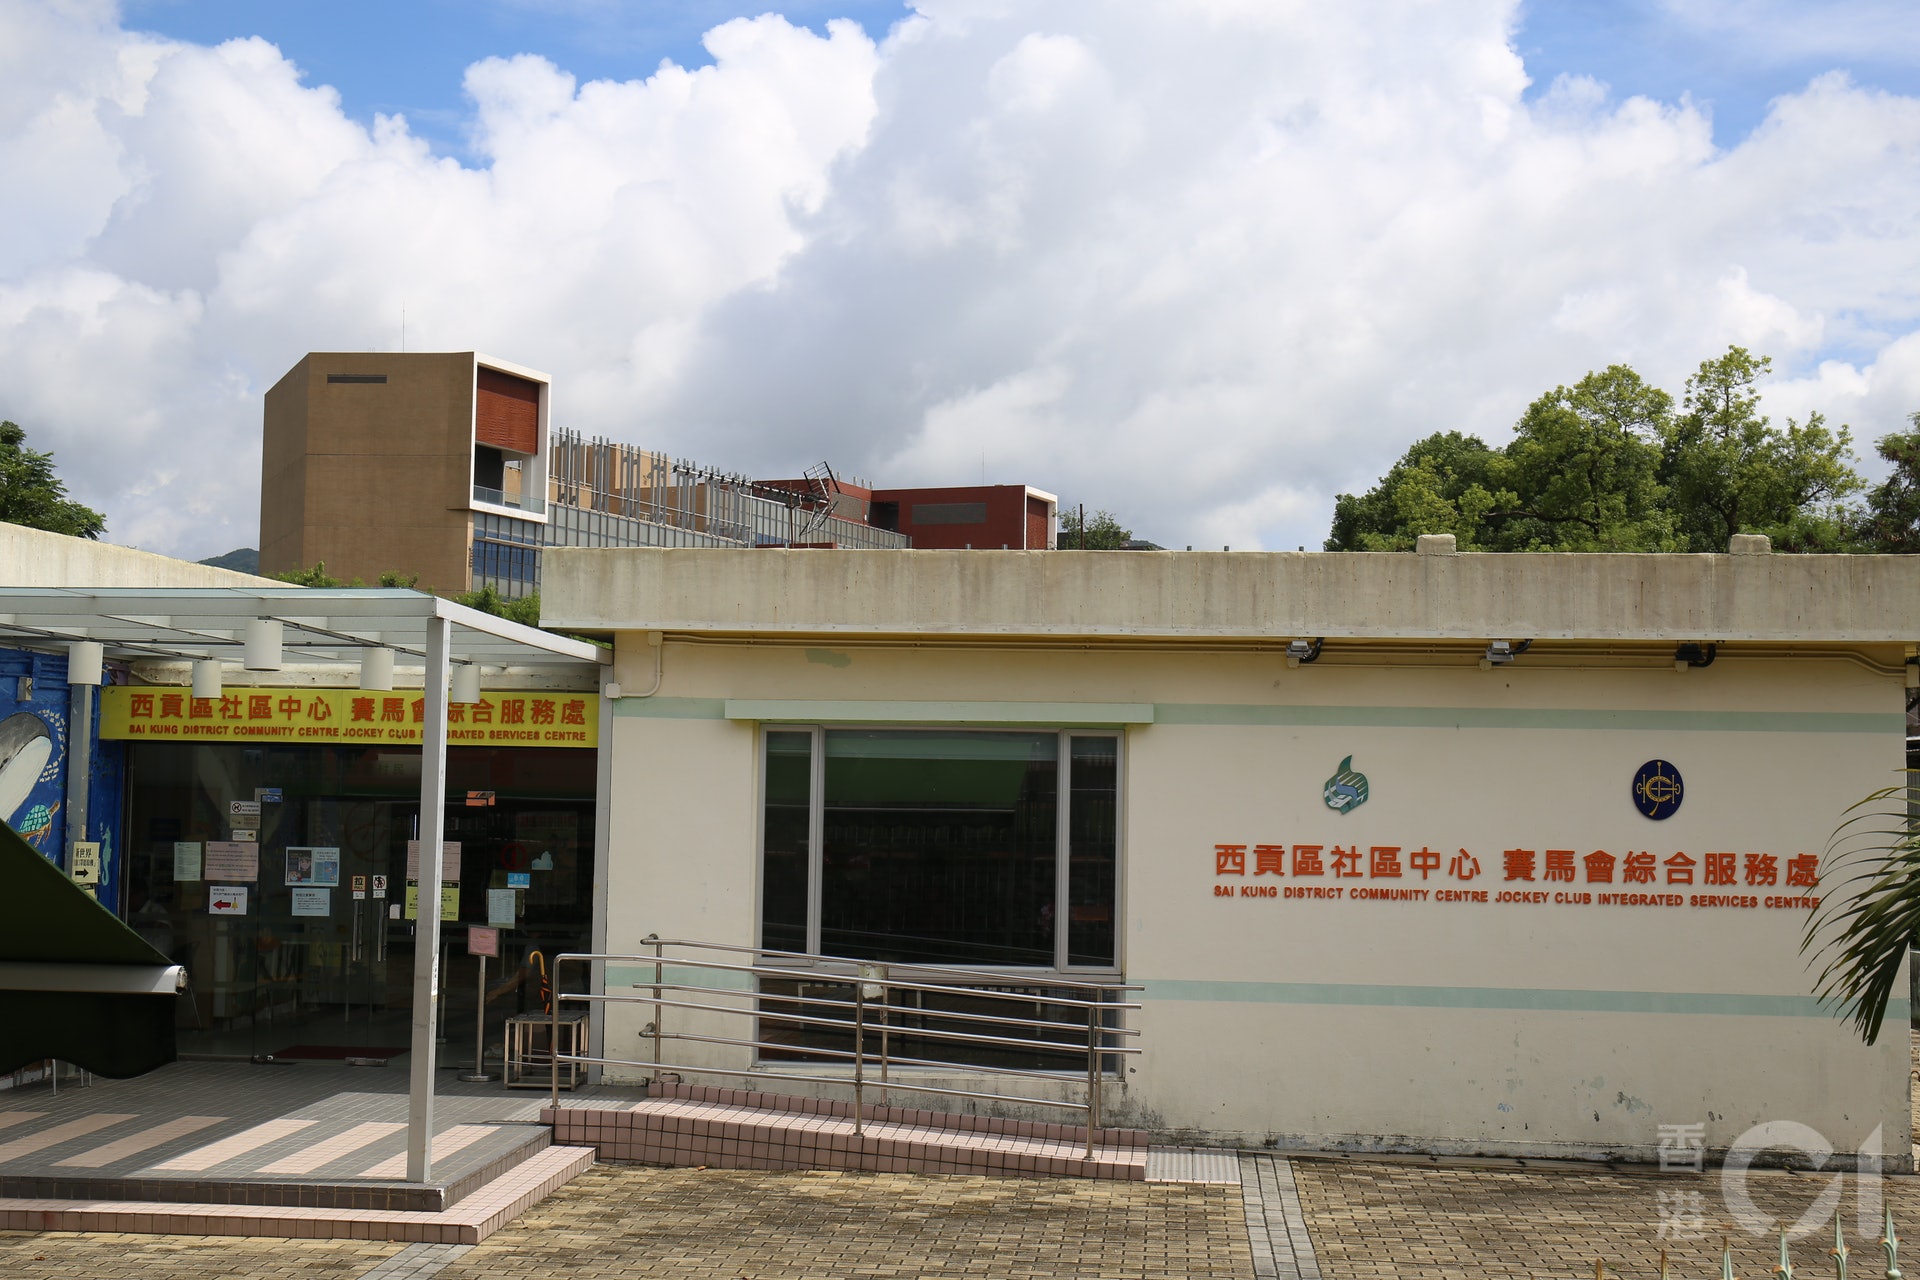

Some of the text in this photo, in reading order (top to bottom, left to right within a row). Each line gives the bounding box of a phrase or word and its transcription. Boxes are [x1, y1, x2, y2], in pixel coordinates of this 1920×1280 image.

[130, 694, 332, 721] 西貢區社區中心
[129, 724, 146, 735] SAI
[150, 724, 178, 735] KUNG
[183, 725, 230, 736] DISTRICT
[233, 726, 295, 736] COMMUNITY
[298, 727, 340, 737] CENTRE
[342, 727, 384, 738] JOCKEY
[388, 728, 416, 739] CLUB
[489, 730, 540, 741] SERVICES
[544, 731, 586, 741] CENTRE
[1214, 844, 1820, 888] 西貢區社區中心 賽馬會綜合服務處
[354, 876, 364, 886] 拉
[1214, 885, 1821, 910] SAI KUNG DISTRICT COMMUNITY CENTRE JOCKEY CLUB INTEGRATED SERVICES CENTRE
